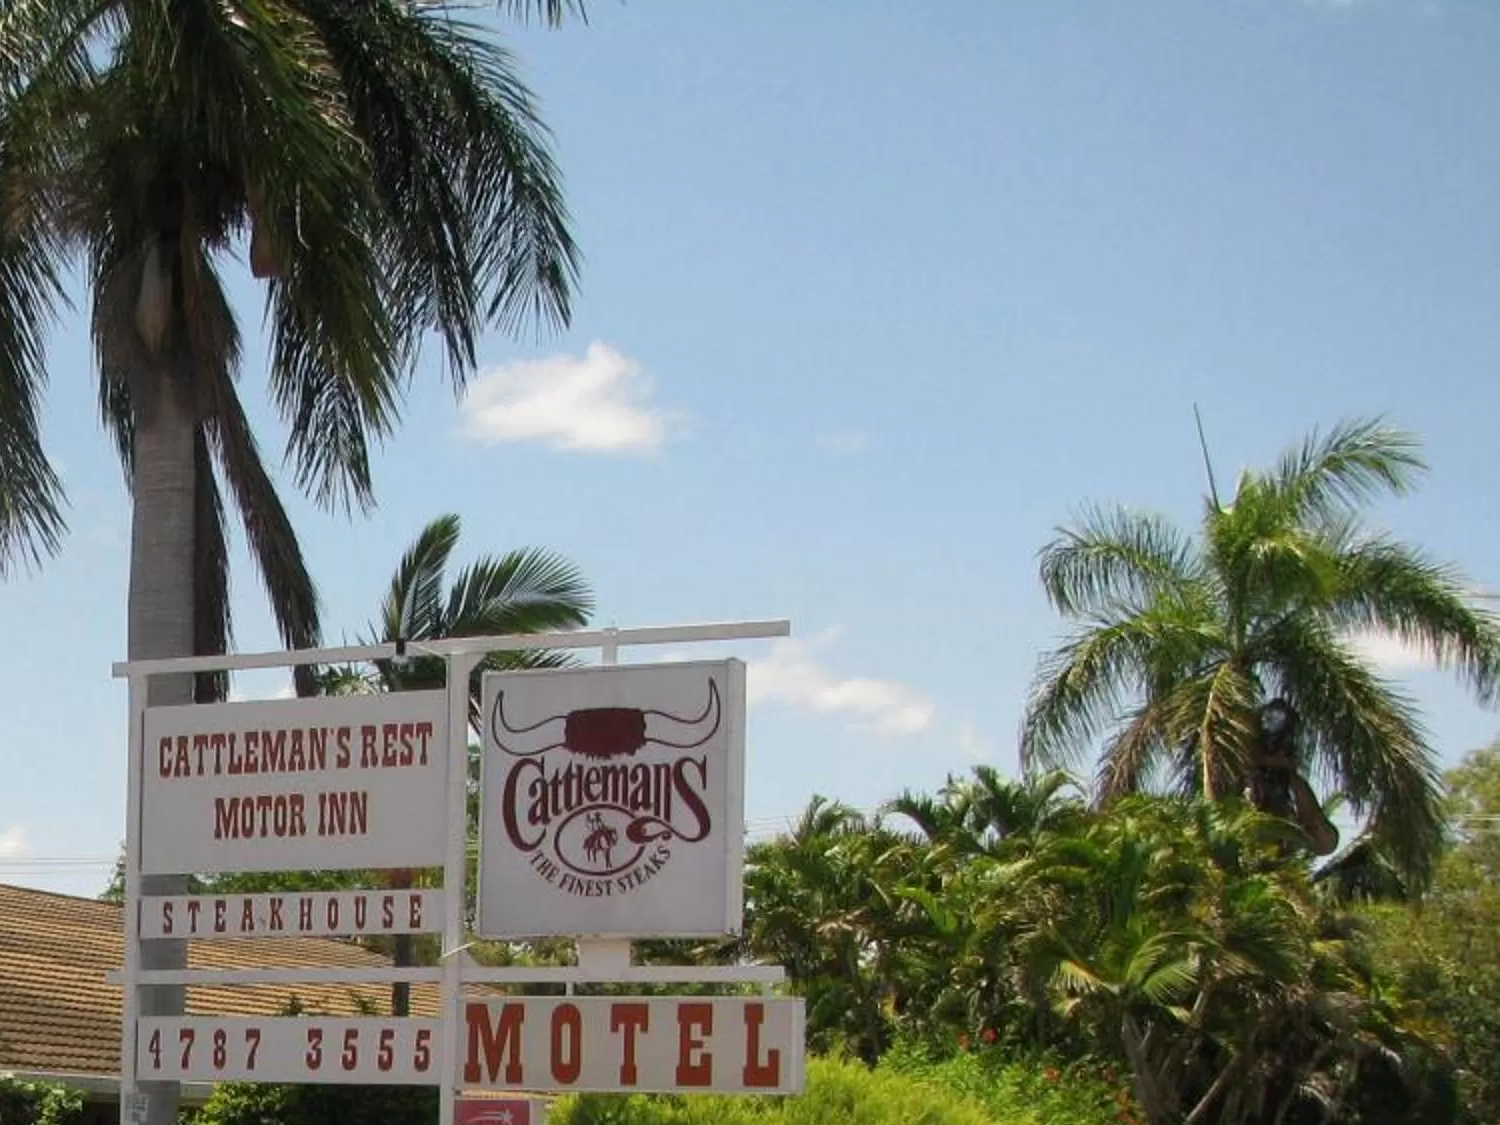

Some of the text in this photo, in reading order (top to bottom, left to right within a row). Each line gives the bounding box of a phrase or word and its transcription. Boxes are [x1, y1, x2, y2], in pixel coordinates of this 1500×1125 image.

[159, 721, 433, 778] CATTLEMAN'S REST
[214, 791, 368, 840] MOTOR INN
[529, 845, 672, 897] THE FINEST STEAKS
[162, 894, 422, 935] STEAKHOUSE
[148, 1028, 432, 1073] 4787 3555
[463, 1002, 780, 1088] MOTEL
